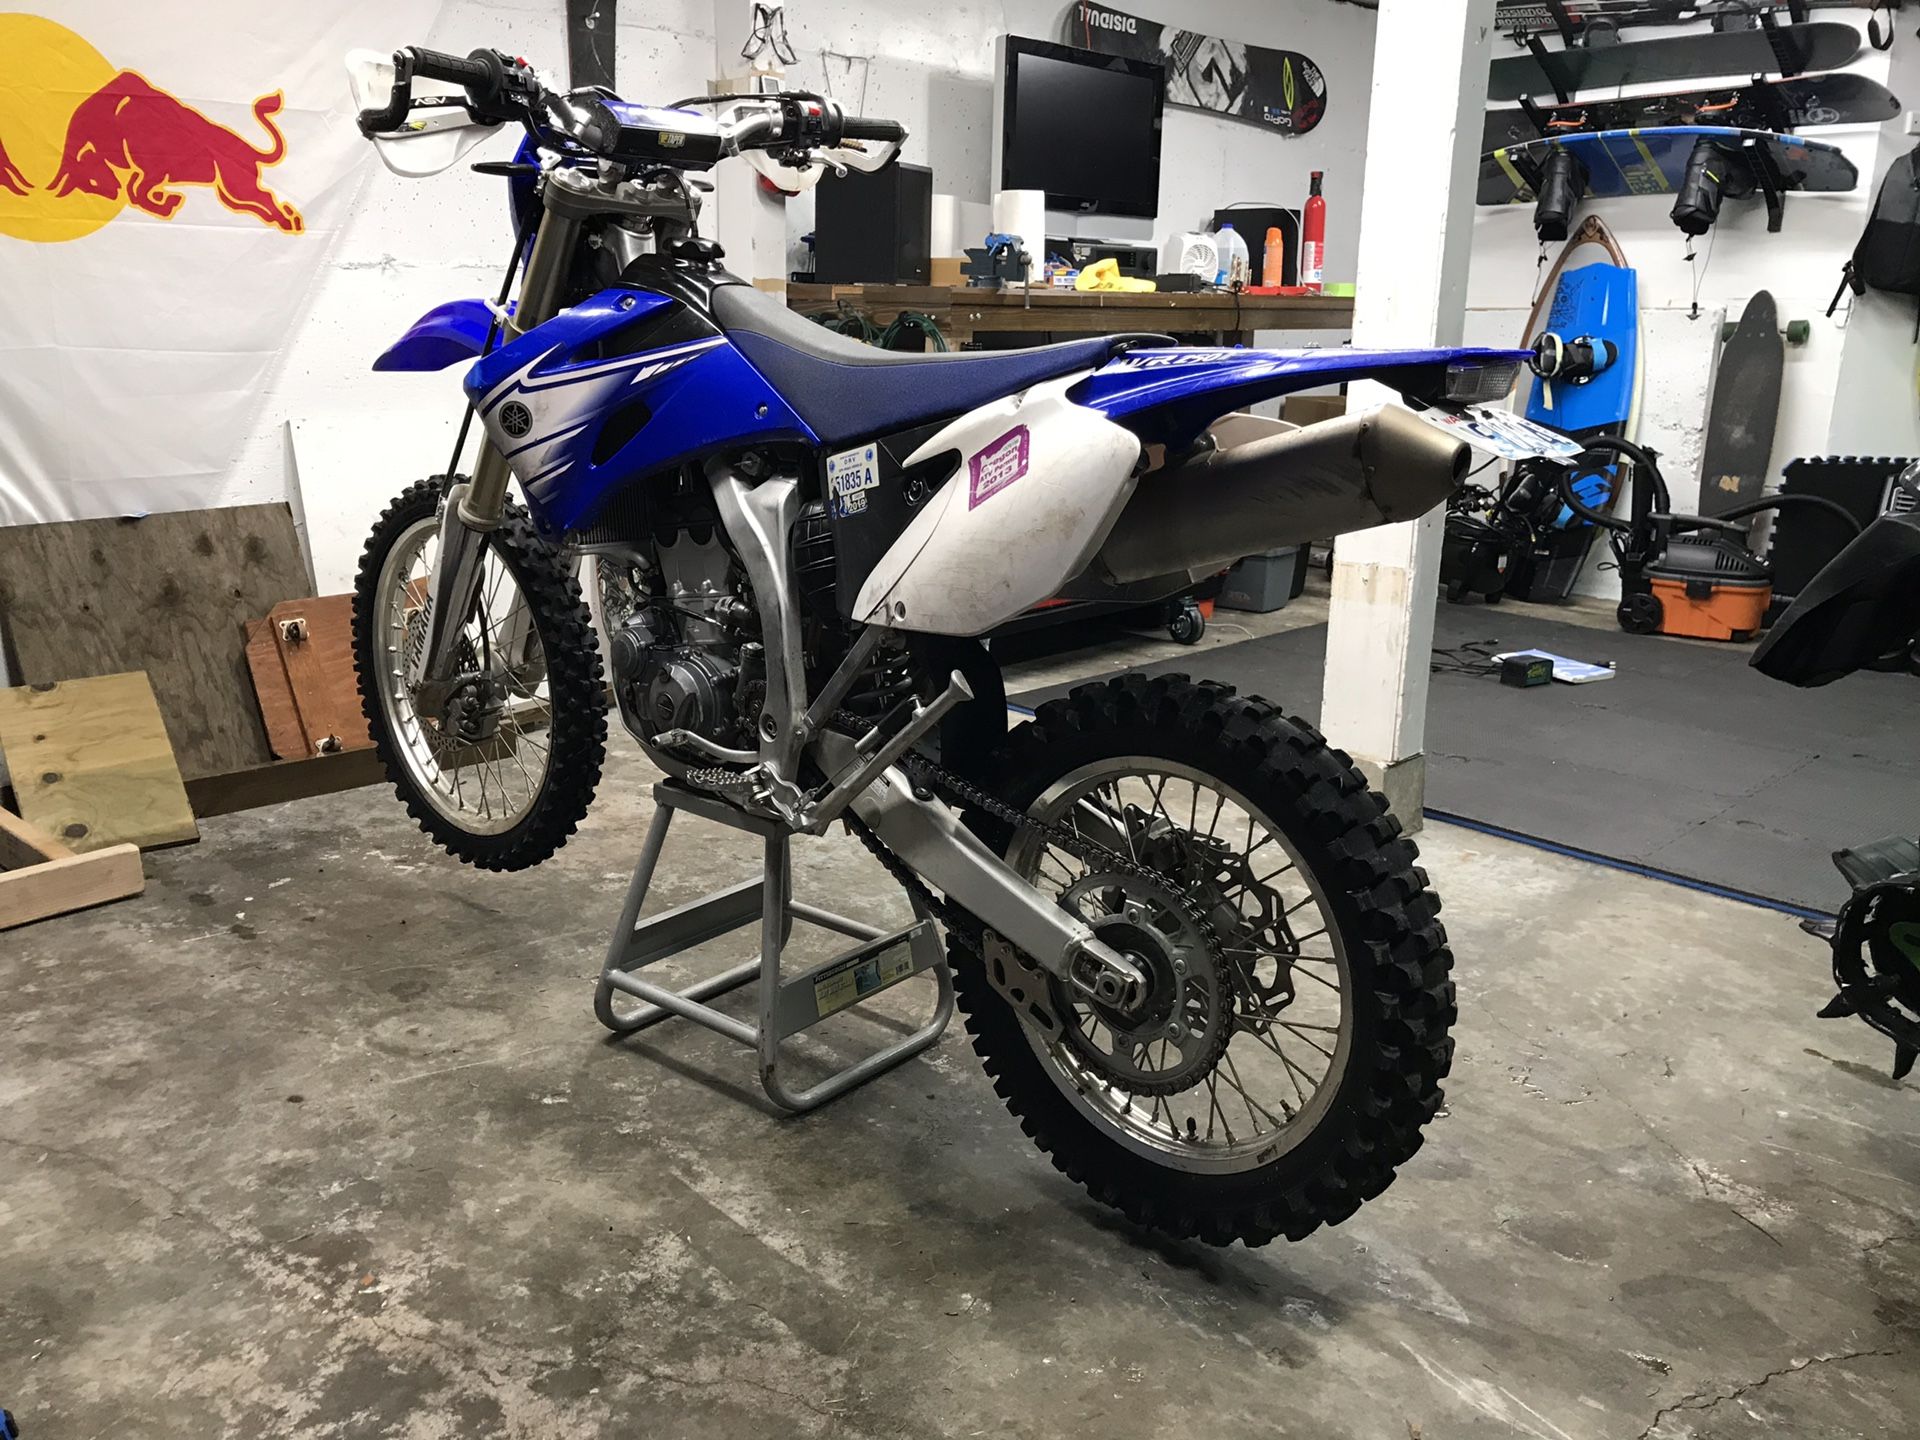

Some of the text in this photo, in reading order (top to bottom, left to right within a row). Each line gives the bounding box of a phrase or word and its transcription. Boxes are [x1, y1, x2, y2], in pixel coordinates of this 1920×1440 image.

[1496, 7, 1552, 18] OSSIGNOL
[414, 96, 446, 106] ASV
[1263, 114, 1292, 127] GoPro
[980, 454, 1018, 482] ATV Permit
[982, 465, 1012, 489] 2013
[831, 468, 873, 492] 51835 A
[849, 498, 866, 511] 2019
[411, 592, 433, 669] YAMAHA
